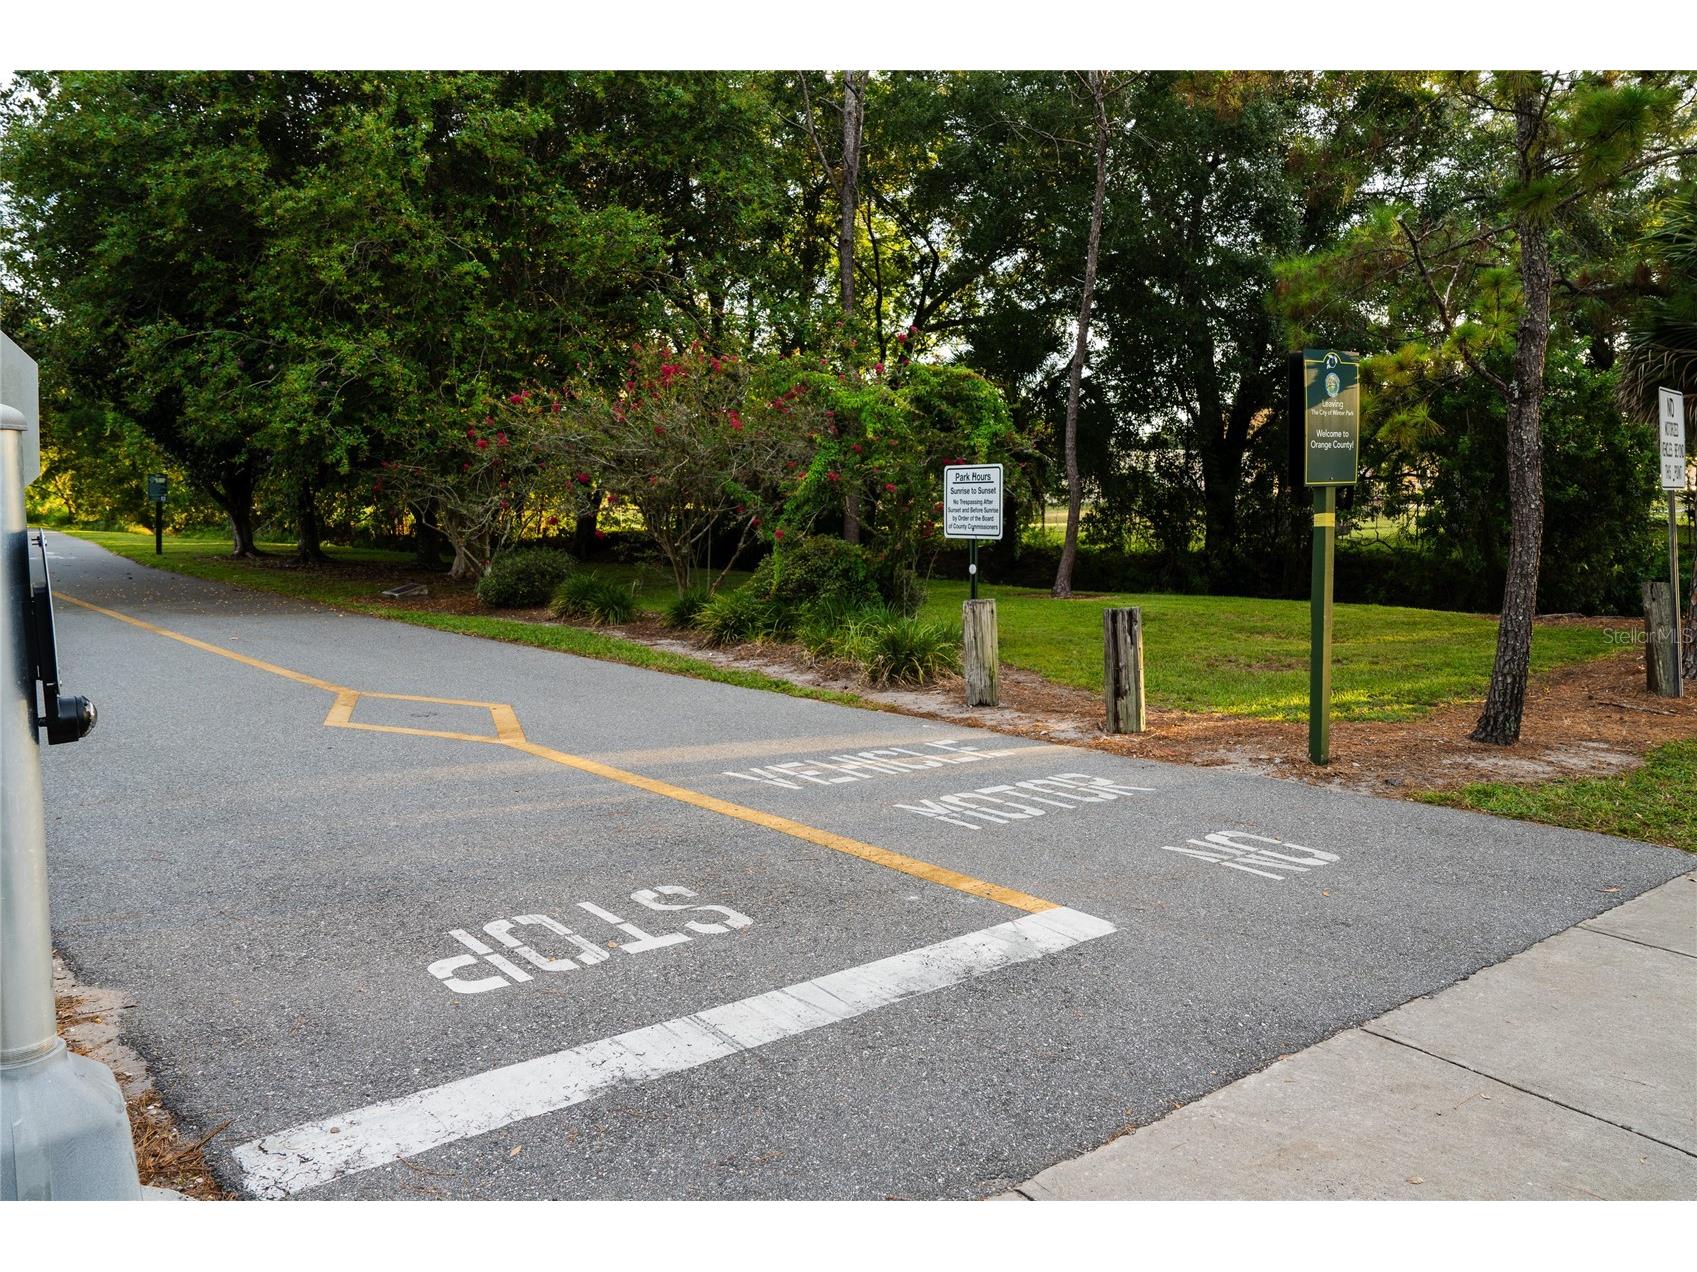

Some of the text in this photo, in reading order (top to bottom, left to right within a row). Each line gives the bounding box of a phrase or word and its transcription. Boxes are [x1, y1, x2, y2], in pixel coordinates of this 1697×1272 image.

[1322, 400, 1344, 410] Leaving
[1310, 440, 1354, 450] Orange County!
[1316, 429, 1342, 437] Welcome
[956, 472, 991, 481] Park Hours
[721, 739, 1016, 790] VEHICLE
[892, 772, 1156, 830] MOTOR
[1161, 830, 1340, 880] NO
[427, 886, 754, 994] STOP
